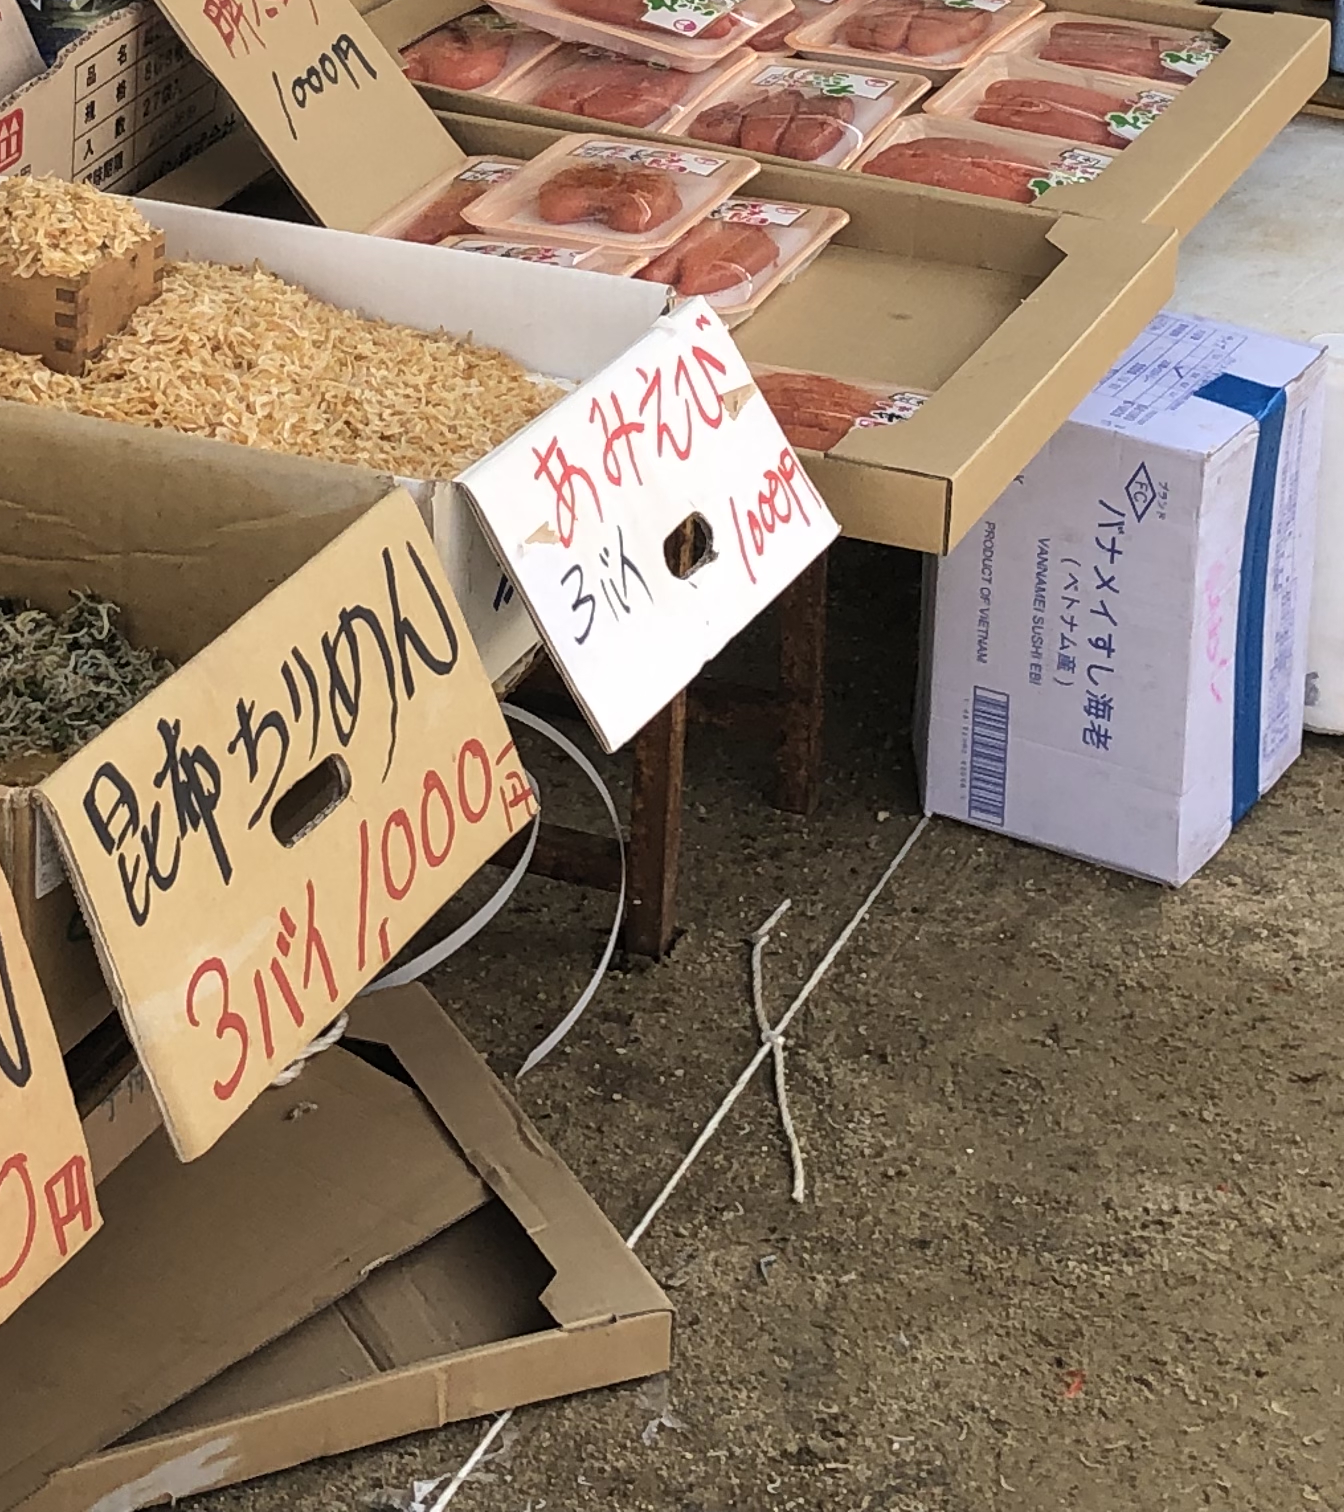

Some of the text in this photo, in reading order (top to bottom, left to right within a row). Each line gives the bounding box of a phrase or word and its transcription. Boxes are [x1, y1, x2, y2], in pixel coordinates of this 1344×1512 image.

[271, 33, 378, 141] 1000円
[728, 446, 823, 586] 1000円
[975, 520, 997, 665] PRODUCT OF VIETNAM
[1028, 537, 1051, 687] VANNAMEI SUSHI EBI
[1081, 498, 1127, 751] バナメイすし海老
[82, 540, 459, 928] 昆布ちりめん
[185, 738, 540, 1101] 3バイ 1,000円
